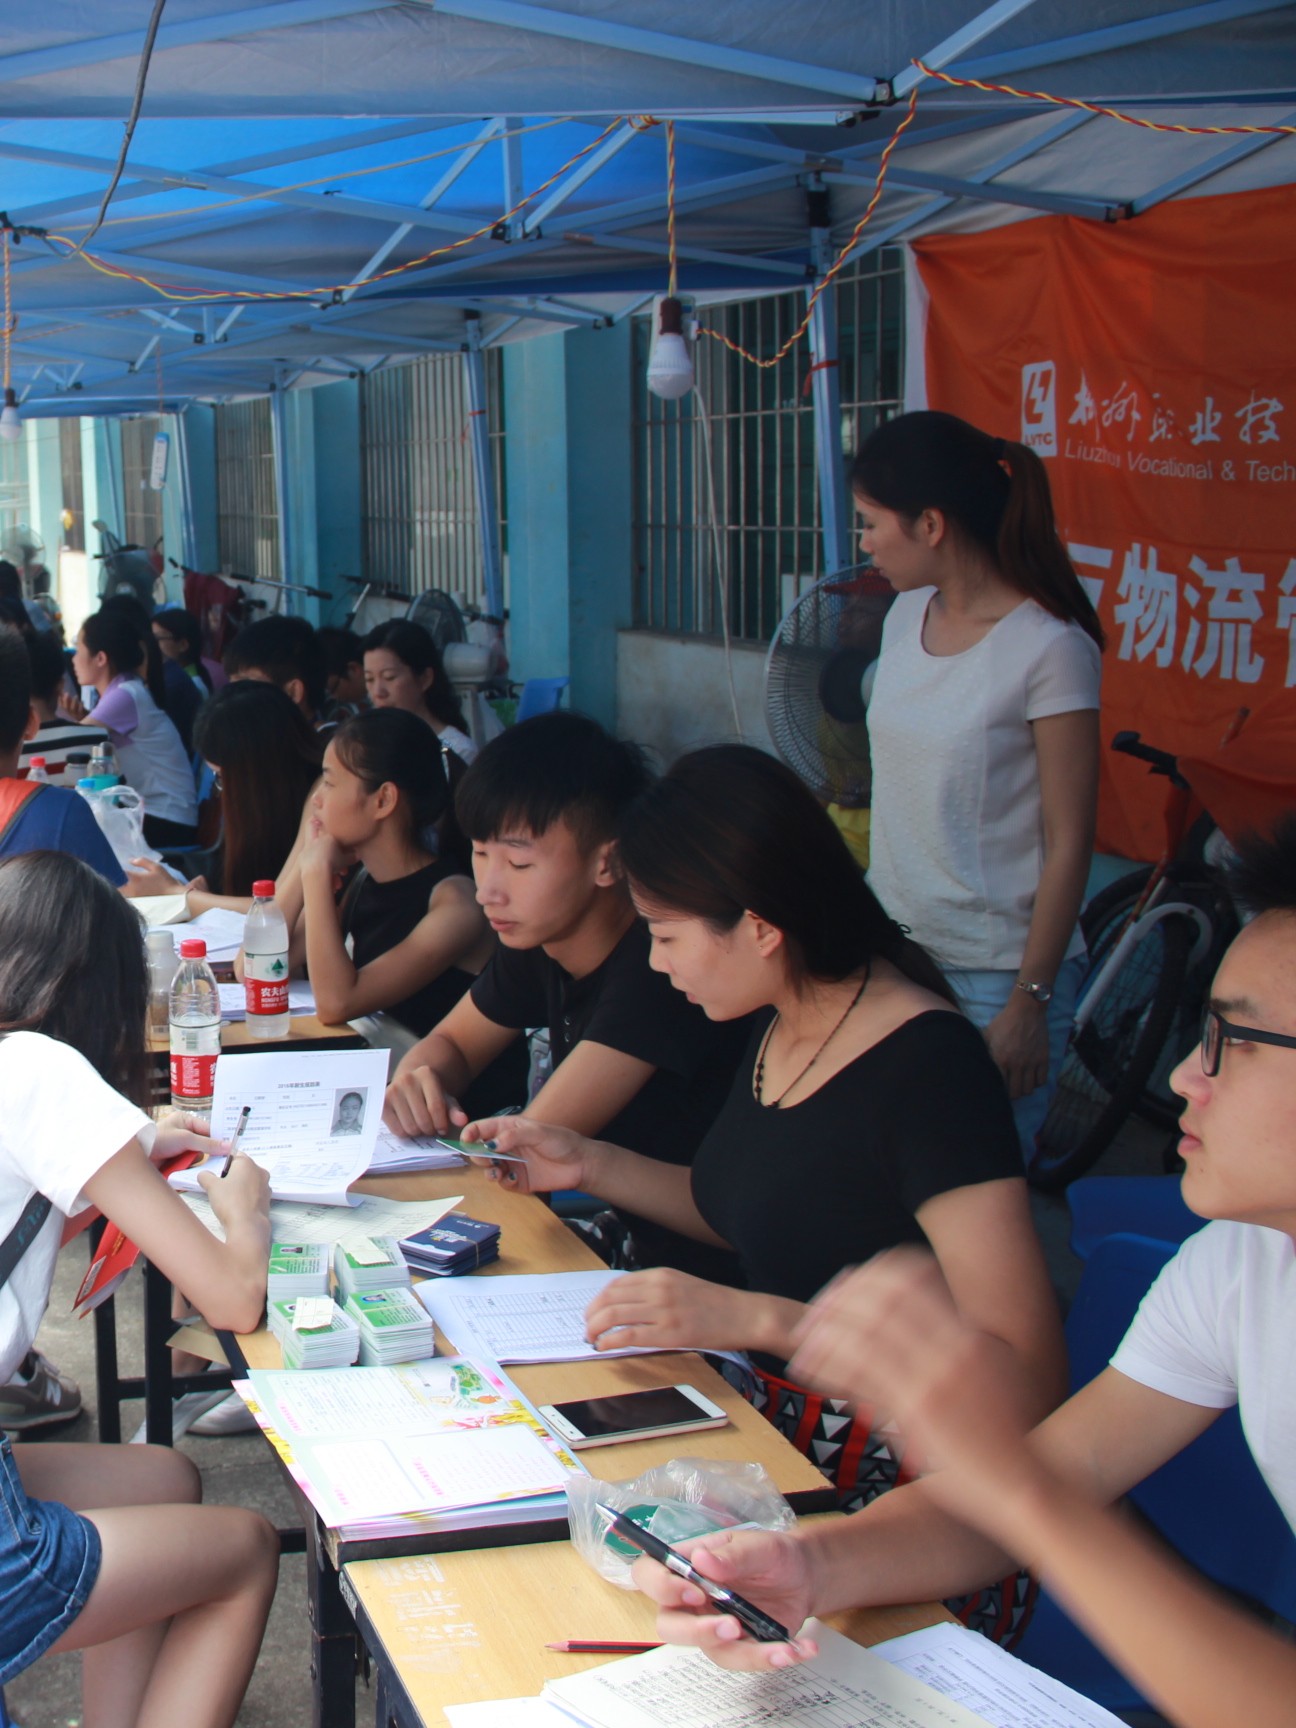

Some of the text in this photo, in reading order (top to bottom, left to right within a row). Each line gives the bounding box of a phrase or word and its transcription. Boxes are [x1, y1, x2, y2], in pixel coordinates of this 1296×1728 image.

[1024, 431, 1054, 447] LVTC
[1128, 452, 1213, 480] Vocational
[1220, 460, 1235, 481] &
[1066, 541, 1296, 690] 物流
